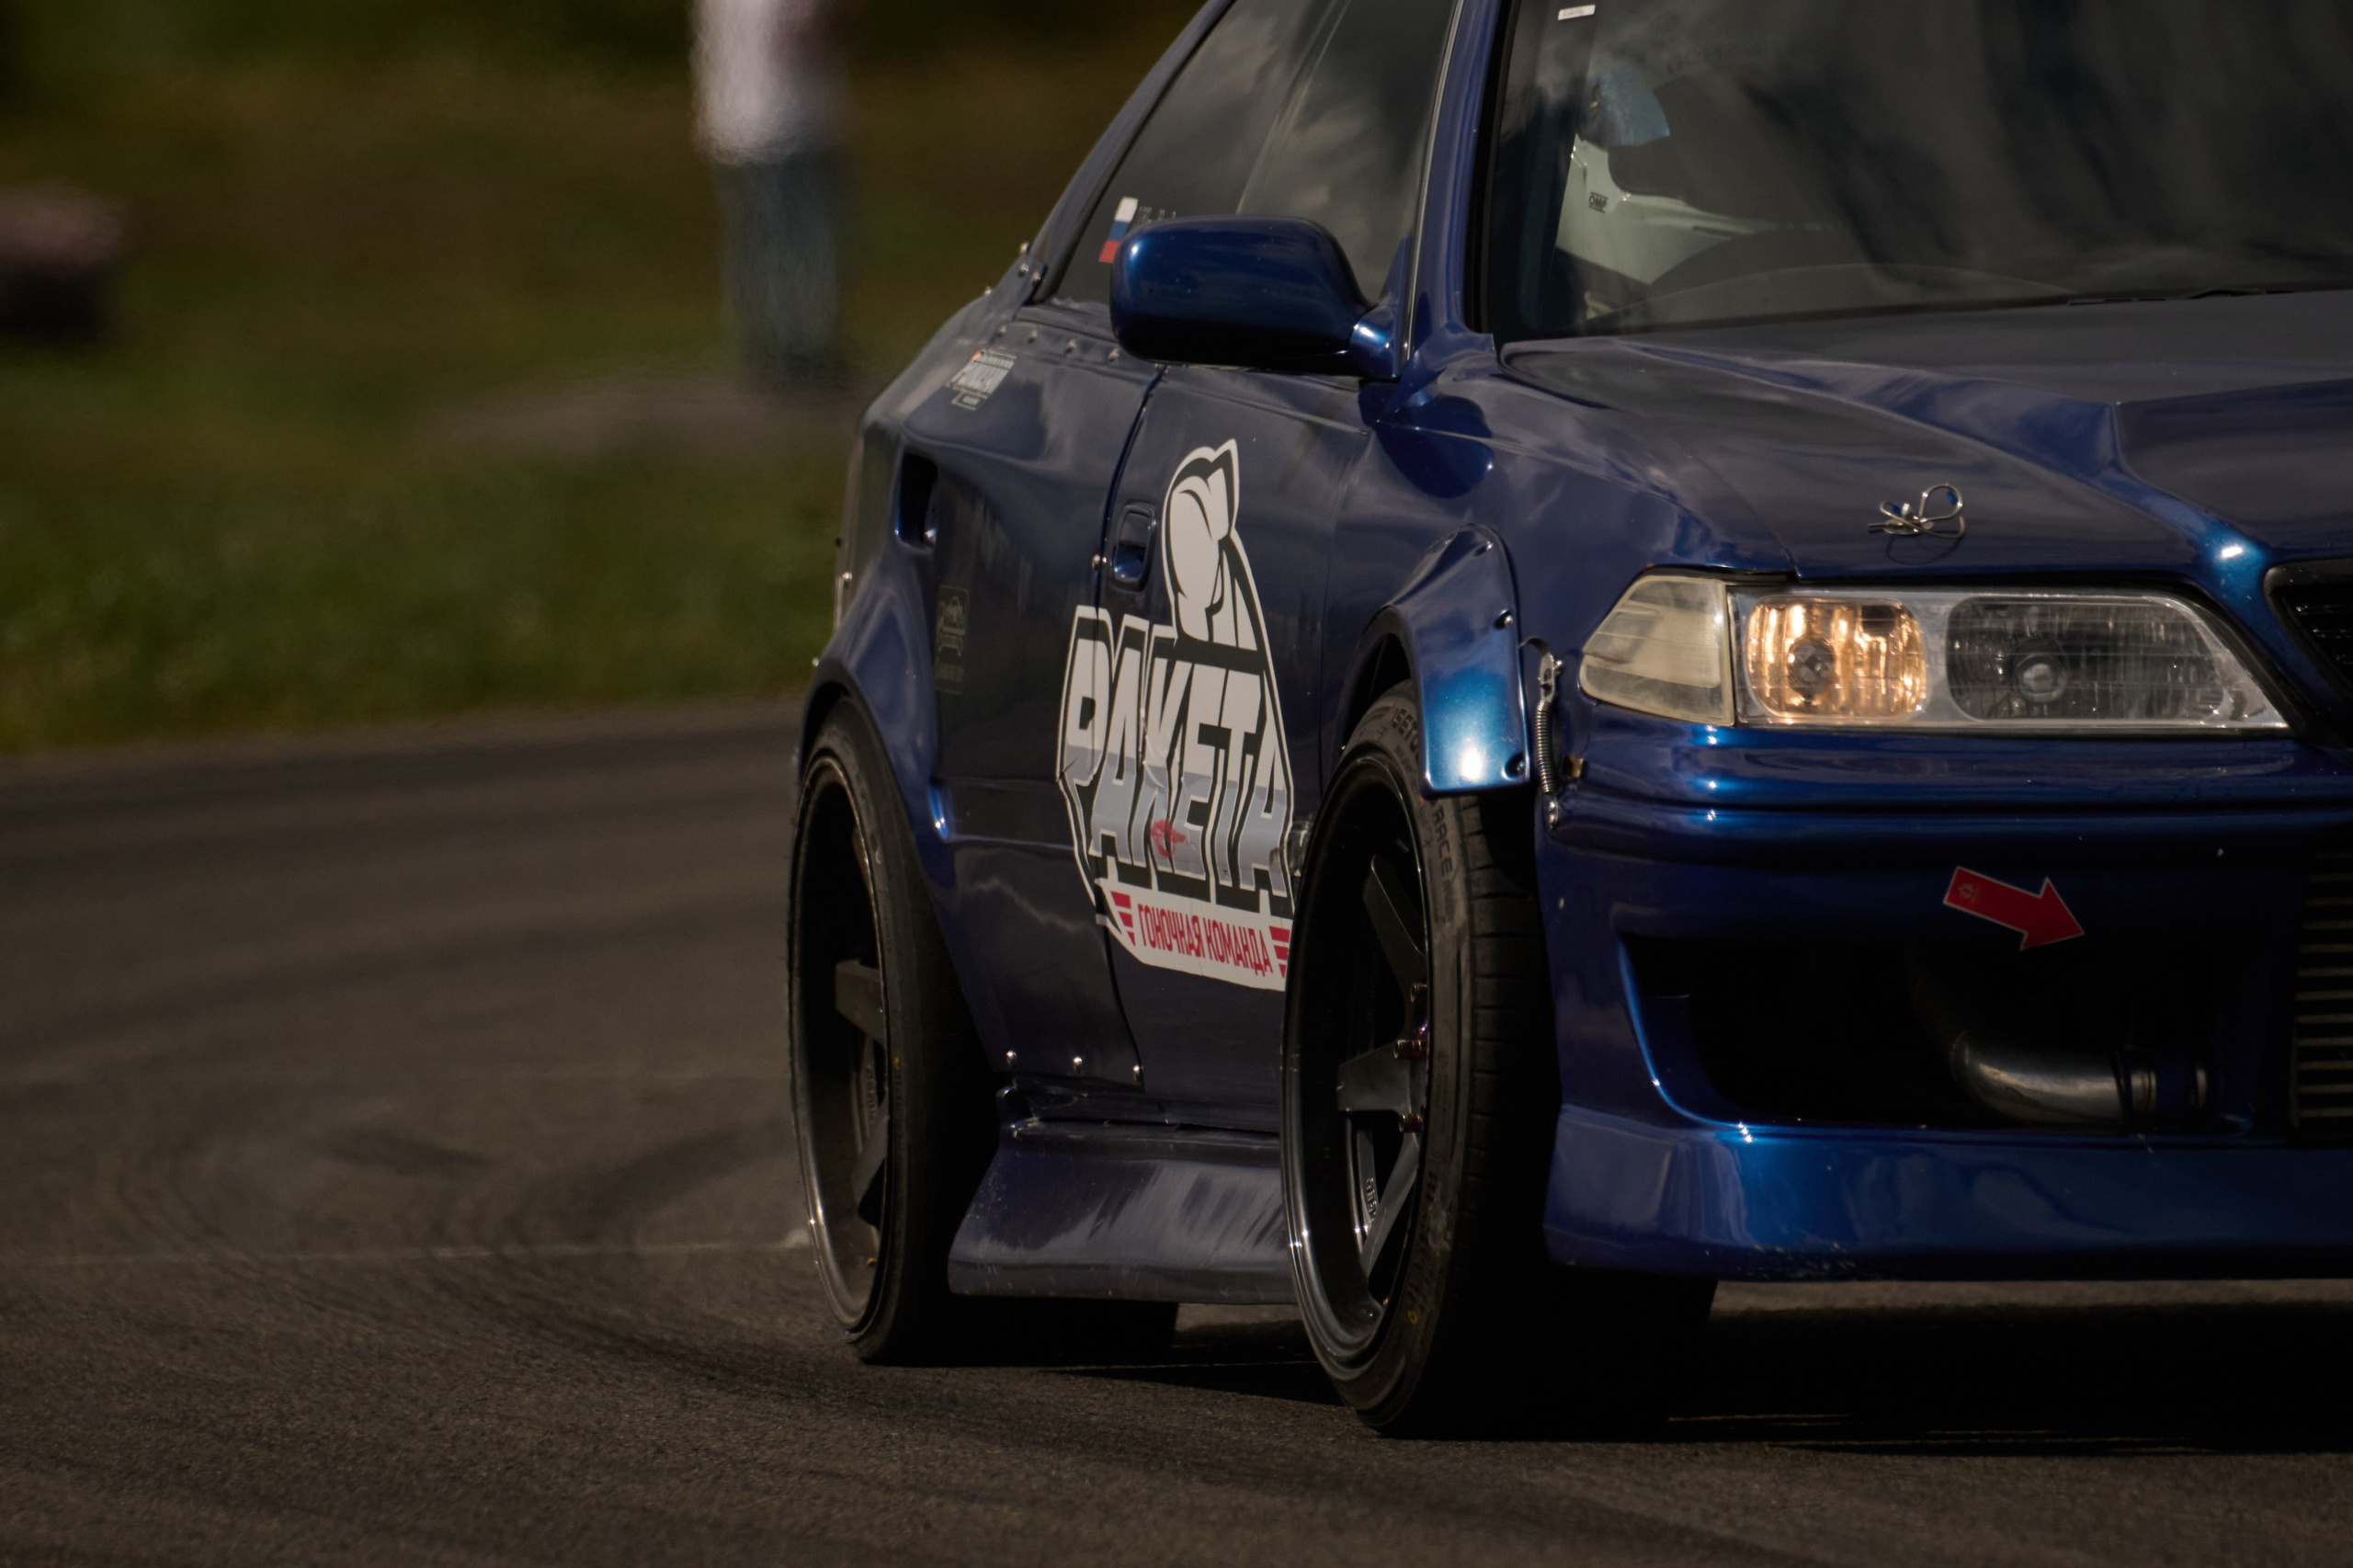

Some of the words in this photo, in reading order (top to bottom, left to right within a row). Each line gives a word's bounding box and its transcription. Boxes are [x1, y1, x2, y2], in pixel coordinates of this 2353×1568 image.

[1588, 193, 1608, 211] OMP
[1063, 632, 1290, 901] РАКЕТА
[1137, 903, 1204, 960] ГОНОЧНАЯ
[1203, 918, 1274, 978] КОМАНДА
